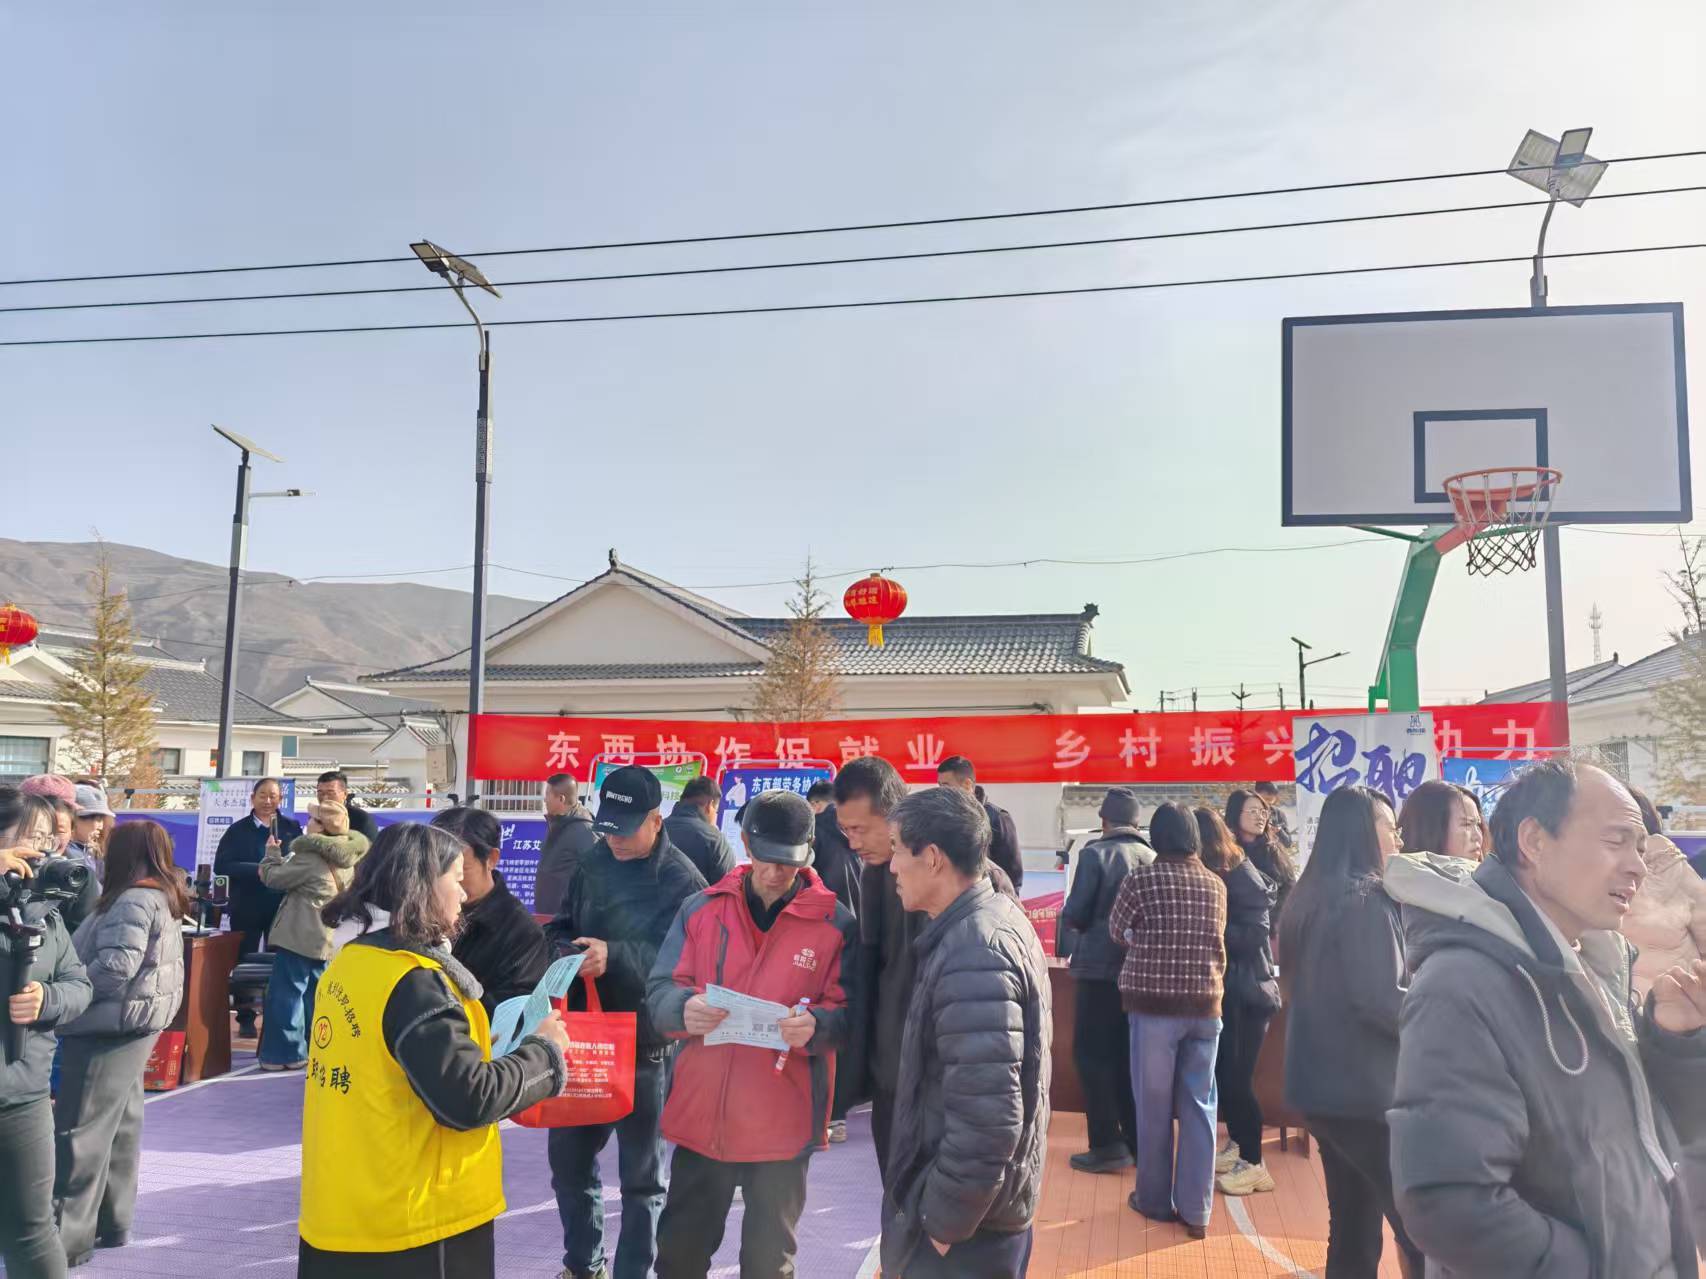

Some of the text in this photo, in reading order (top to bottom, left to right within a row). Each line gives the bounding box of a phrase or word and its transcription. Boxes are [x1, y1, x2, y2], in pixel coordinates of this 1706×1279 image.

[546, 731, 944, 769] 东西协作促就业
